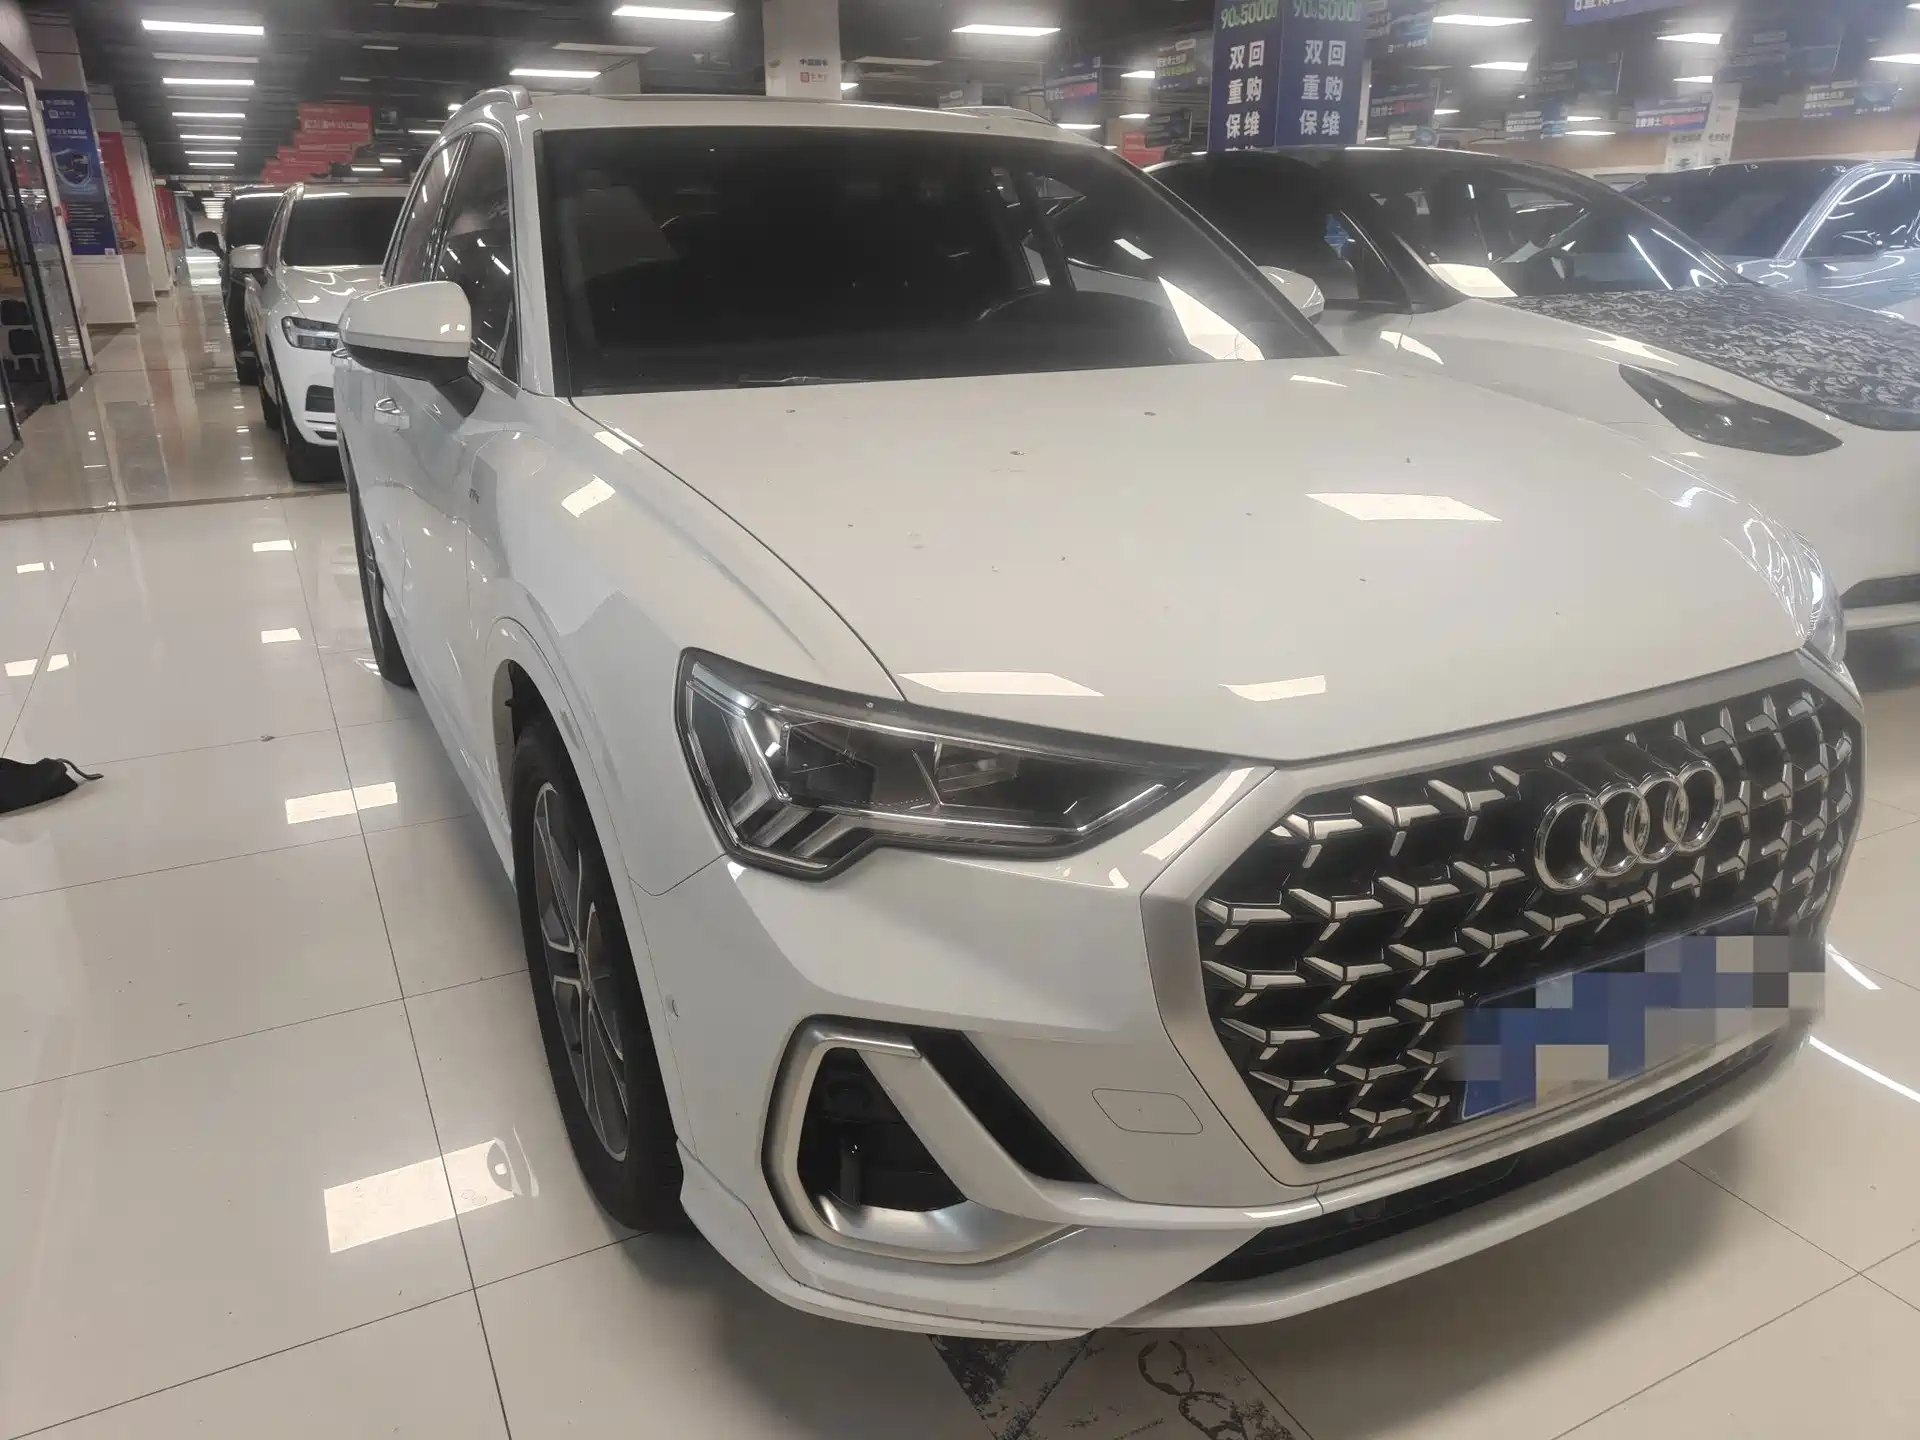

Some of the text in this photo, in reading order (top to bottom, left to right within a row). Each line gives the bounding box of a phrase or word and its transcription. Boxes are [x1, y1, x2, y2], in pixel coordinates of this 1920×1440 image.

[1224, 44, 1246, 151] 双重保
[1243, 39, 1265, 150] 回购维
[1298, 39, 1324, 136] 双重保
[1320, 39, 1347, 136] 回购维
